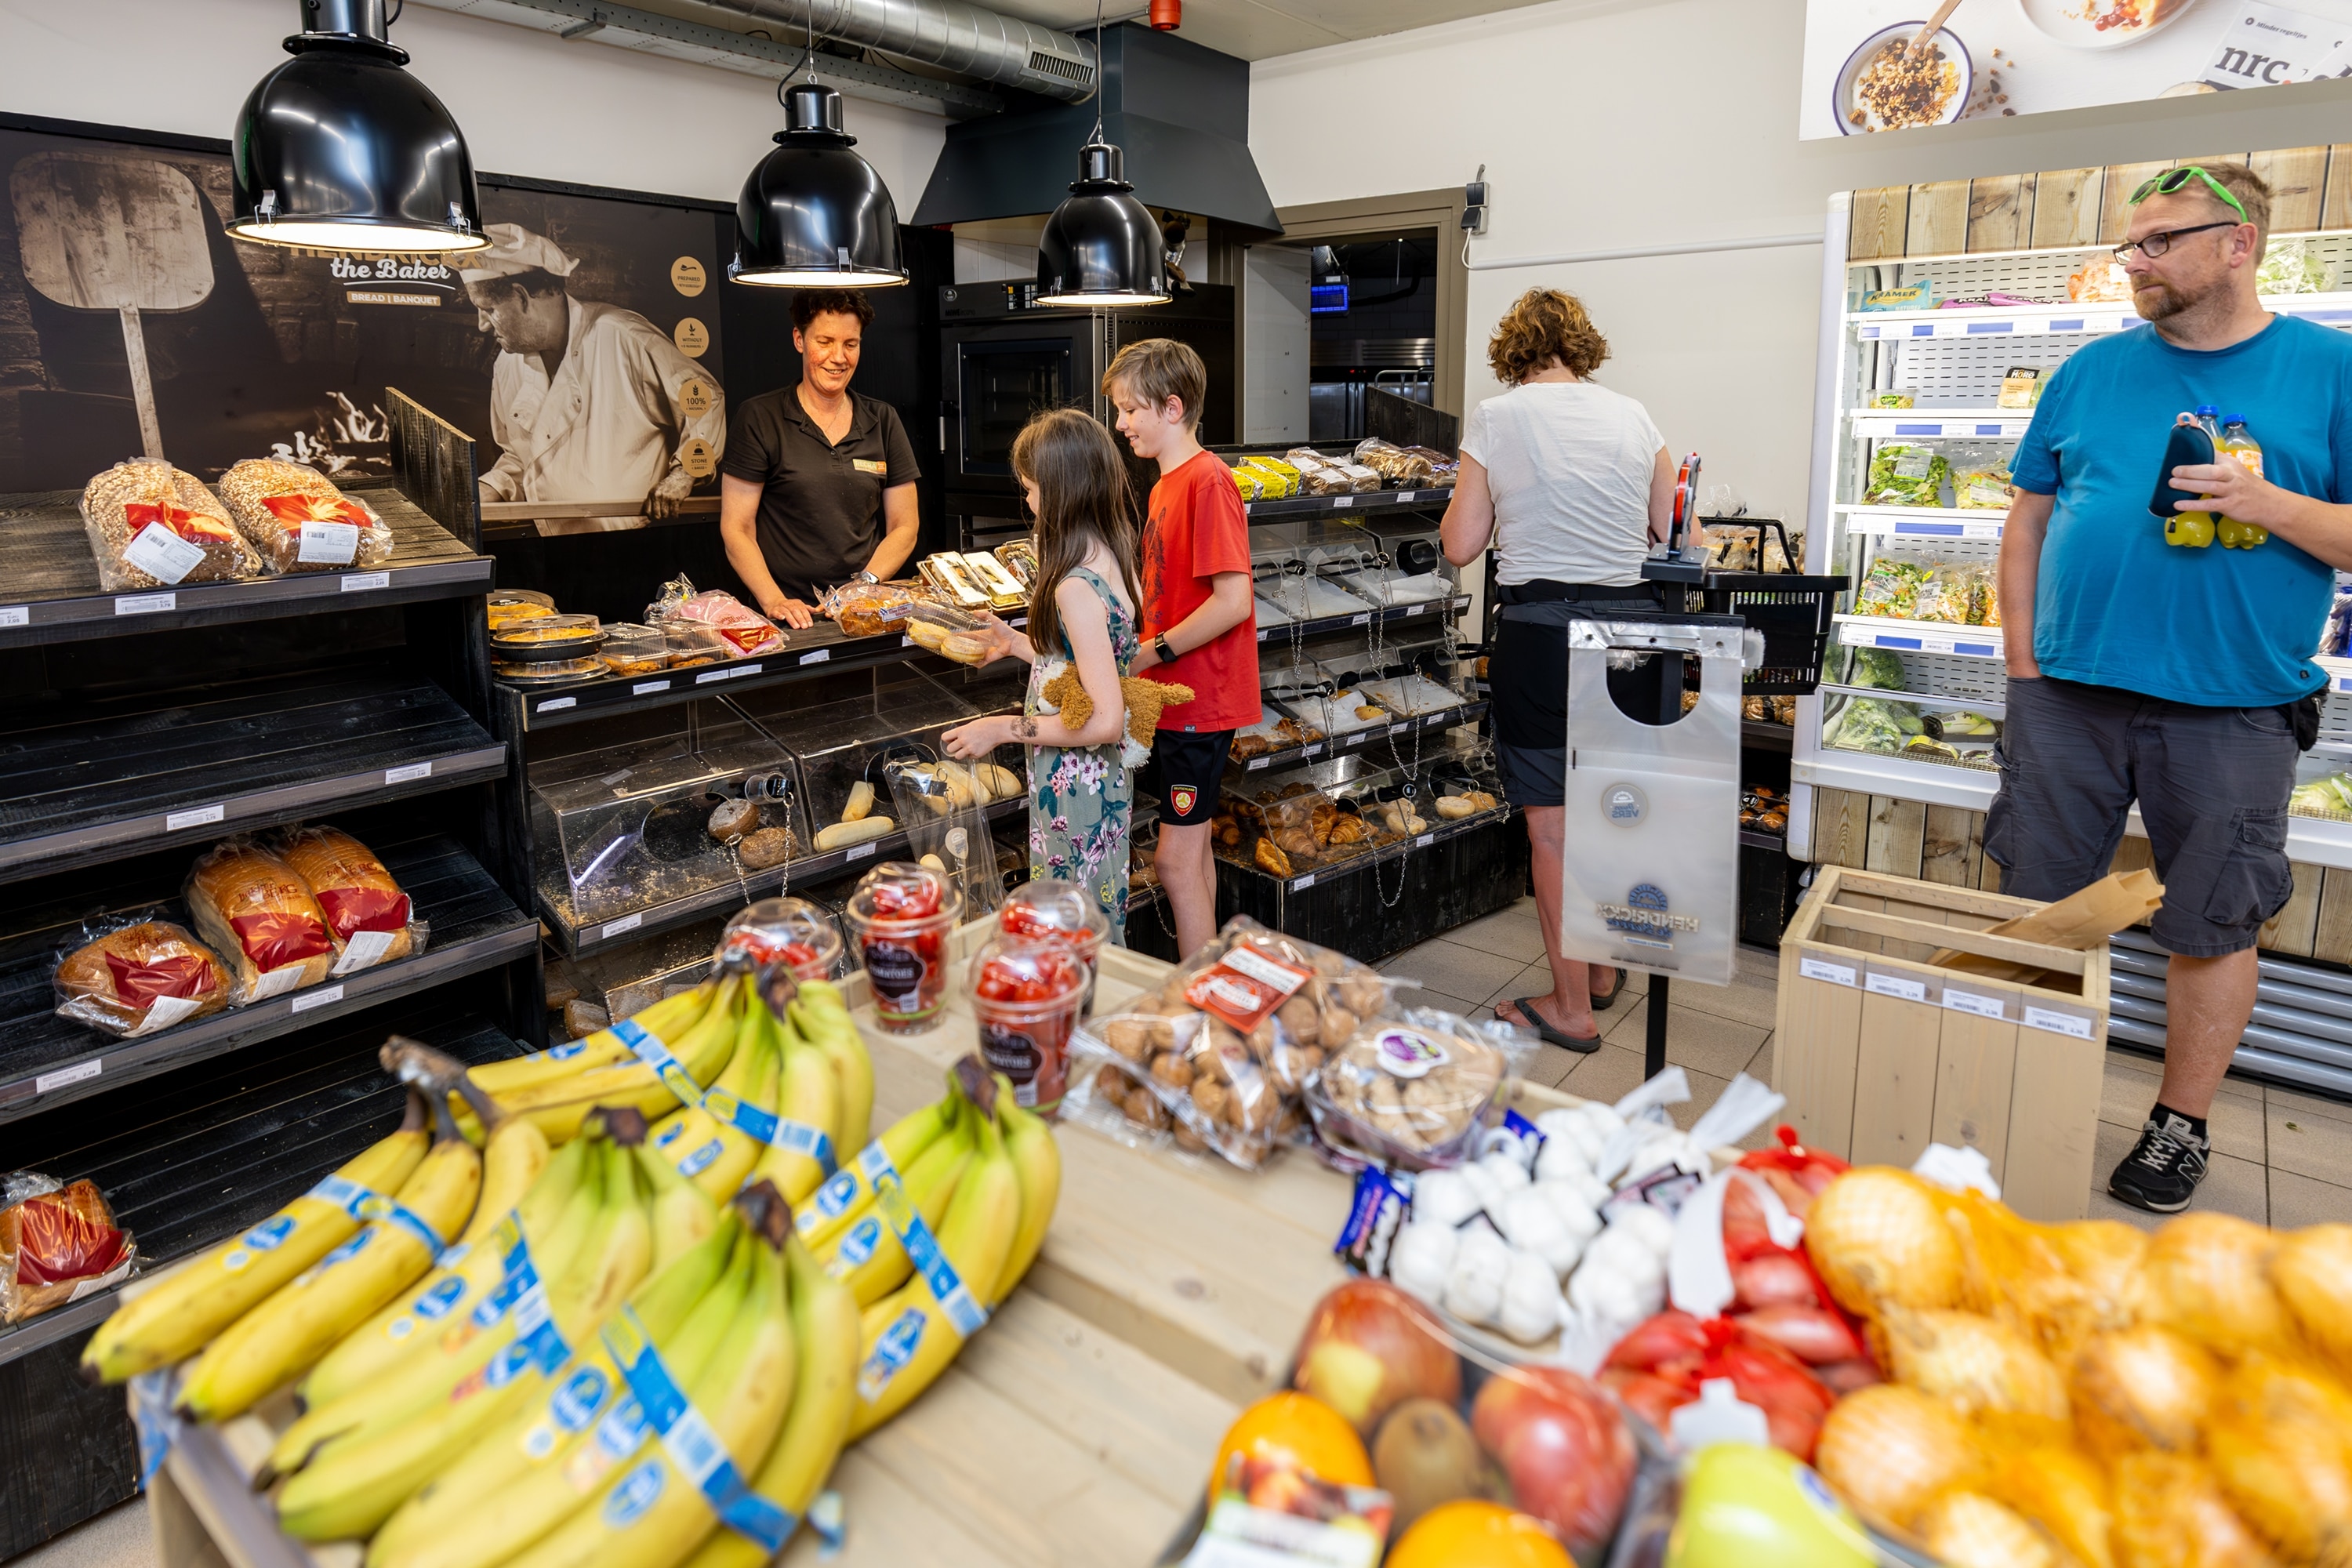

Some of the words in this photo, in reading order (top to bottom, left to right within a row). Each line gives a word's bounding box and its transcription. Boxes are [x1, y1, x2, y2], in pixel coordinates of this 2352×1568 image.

[2256, 21, 2279, 32] Minder
[2280, 27, 2307, 39] regeltjes
[329, 257, 372, 278] the
[375, 258, 451, 279] Baker
[350, 292, 385, 303] BREAD
[393, 295, 438, 305] BANQUET
[1870, 290, 1917, 302] KRAMER
